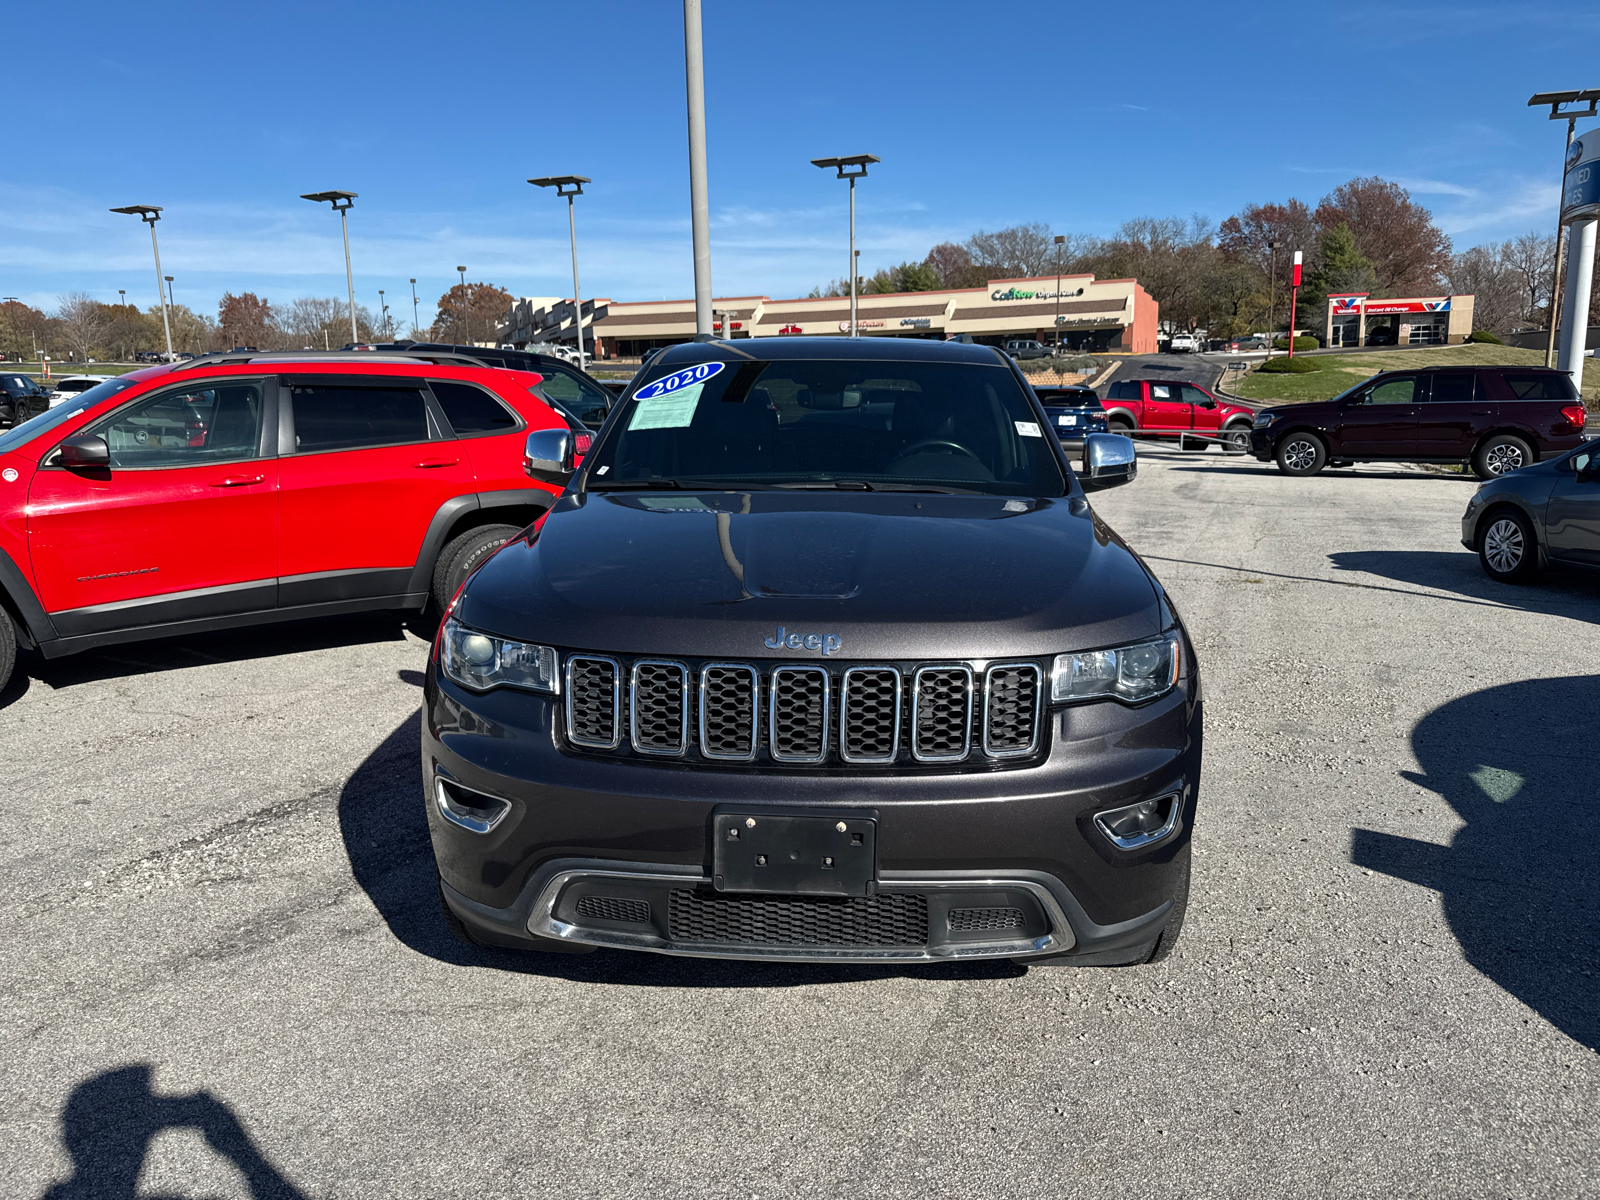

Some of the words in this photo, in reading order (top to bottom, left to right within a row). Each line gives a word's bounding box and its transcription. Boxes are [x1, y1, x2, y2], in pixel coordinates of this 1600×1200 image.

[652, 364, 709, 397] 2020
[463, 539, 507, 570] Fireston
[77, 566, 159, 582] CHEROKEE
[763, 626, 842, 656] Jeep
